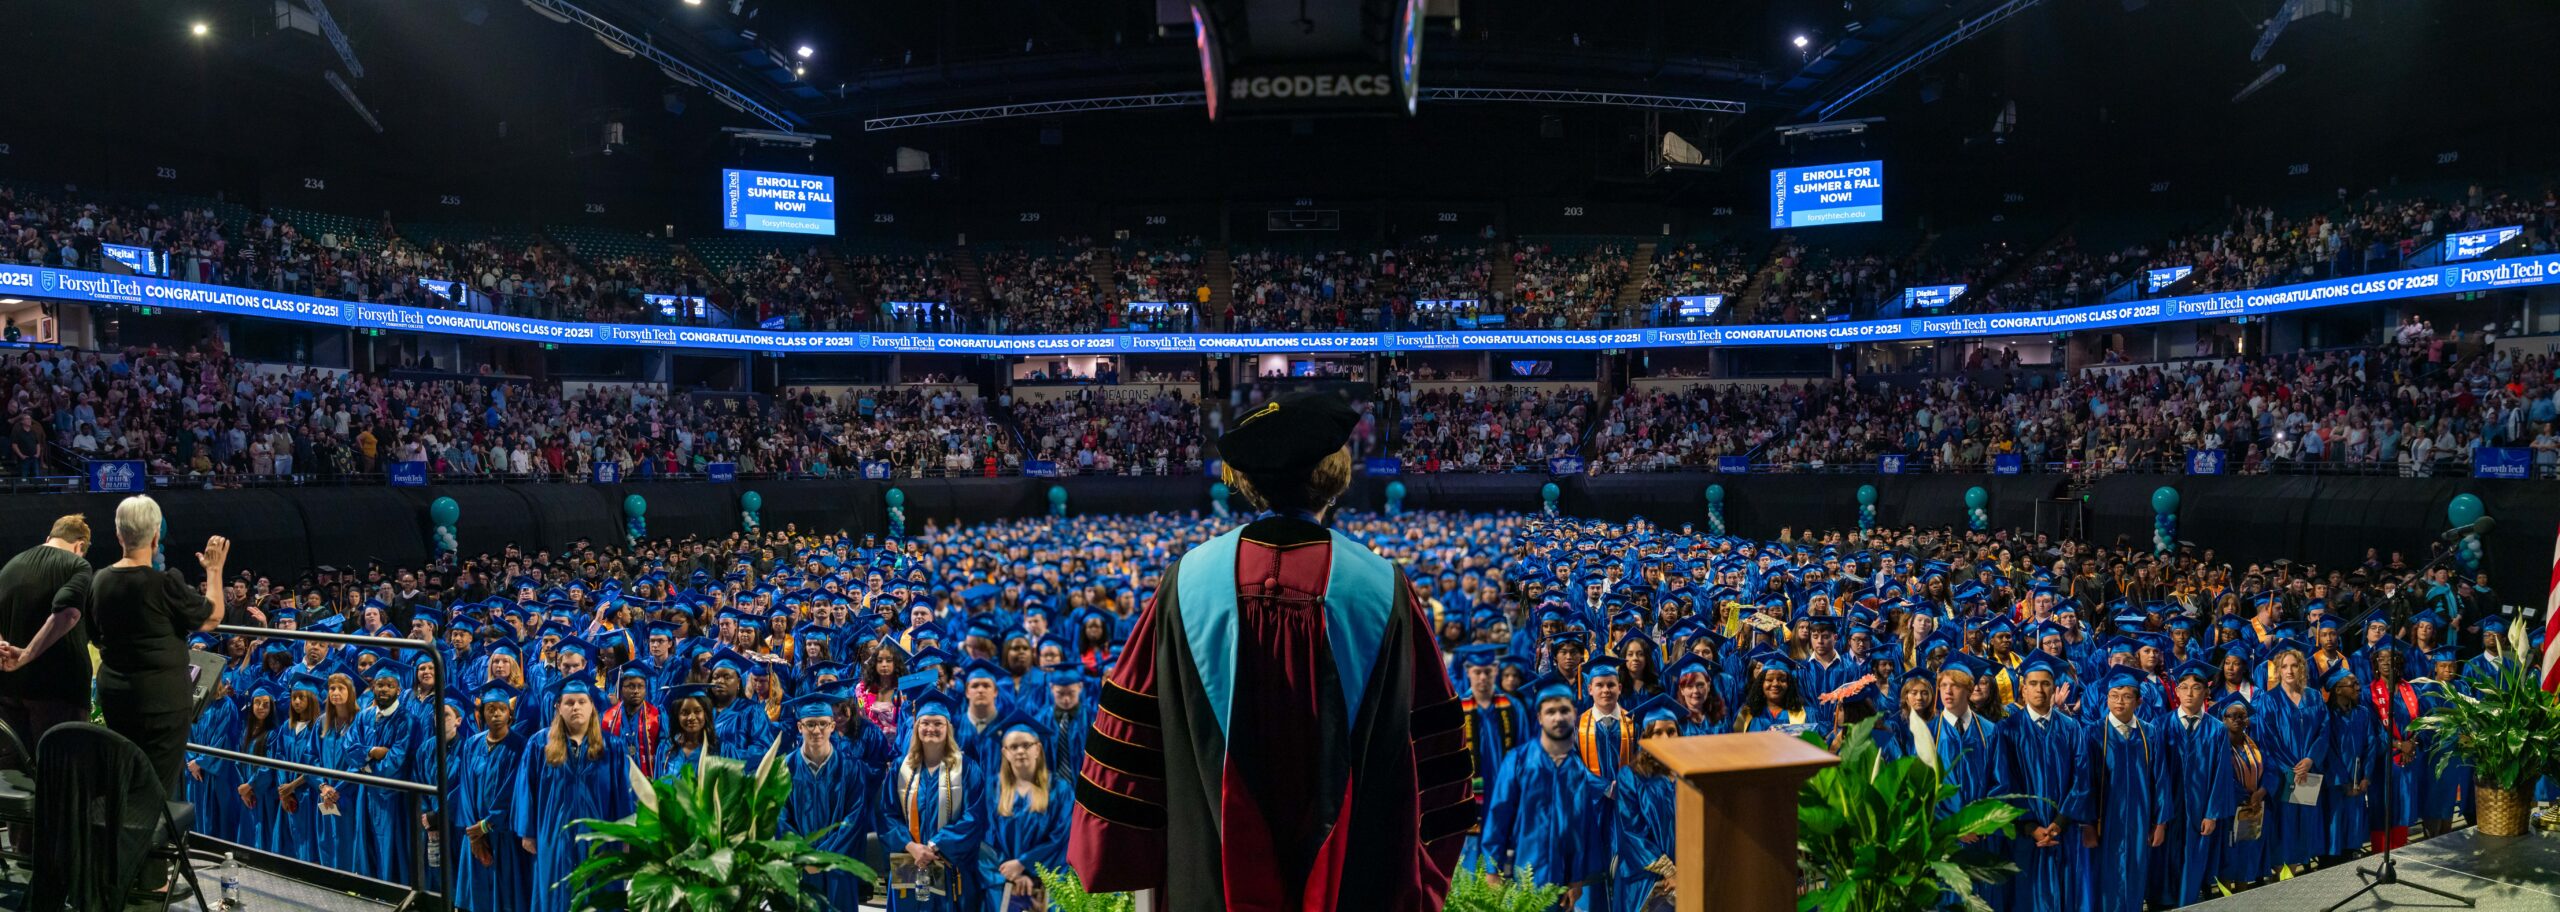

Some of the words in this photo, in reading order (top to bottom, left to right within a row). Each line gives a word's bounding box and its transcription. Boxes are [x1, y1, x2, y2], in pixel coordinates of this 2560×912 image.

[1231, 75, 1390, 98] #GODEACS
[2437, 152, 2459, 164] 209
[157, 167, 176, 179] 233
[1803, 169, 1846, 181] ENROLL
[1848, 167, 1870, 177] FOR
[2288, 164, 2309, 175] 208
[305, 178, 324, 189] 234
[729, 172, 737, 190] Tech
[757, 177, 800, 189] ENROLL
[801, 180, 823, 190] FOR
[1776, 171, 1784, 189] Tech
[1794, 182, 1841, 194] SUMMER
[1844, 180, 1852, 190] &
[1854, 178, 1880, 189] FALL
[2150, 182, 2170, 192] 207
[440, 195, 461, 205] 235
[748, 188, 796, 200] SUMMER
[798, 191, 806, 201] &
[808, 192, 832, 203] FALL
[1820, 192, 1852, 203] NOW!
[2004, 193, 2024, 202] 206
[585, 203, 605, 213] 236
[729, 191, 738, 218] Forsyth
[775, 201, 806, 212] NOW!
[1776, 189, 1785, 217] Forsyth
[1564, 207, 1583, 216] 203
[1713, 207, 1733, 215] 204
[1807, 211, 1866, 222] forsythtech.edu
[874, 214, 894, 223] 238
[1020, 213, 1040, 222] 239
[1146, 216, 1166, 225] 240
[1438, 213, 1458, 222] 202
[762, 219, 820, 230] forsythtech.edu
[2459, 235, 2486, 247] Digital
[108, 248, 135, 259] Digital
[2462, 265, 2508, 285] Forsyth
[2511, 261, 2543, 276] Tech
[60, 275, 108, 297] Forsyth
[111, 280, 141, 296] Tech
[2248, 285, 2349, 306] CONGRATULATIONS
[2351, 281, 2385, 294] CLASS
[2388, 278, 2404, 290] OF
[2406, 274, 2438, 288] 2025!
[94, 293, 121, 301] COMMUNITY
[146, 285, 259, 307] CONGRATULATIONS
[262, 298, 294, 311] CLASS
[297, 303, 310, 313] OF
[313, 304, 338, 316] 2025!
[1916, 290, 1938, 299] Digital
[2179, 296, 2217, 315] Forsyth
[2219, 295, 2243, 308] Tech
[359, 308, 396, 326] Forsyth
[398, 311, 423, 325] Tech
[1991, 313, 2087, 328] CONGRATULATIONS
[2089, 310, 2117, 321] CLASS
[2119, 308, 2132, 318] OF
[2134, 306, 2159, 317] 2025!
[427, 315, 520, 332] CONGRATULATIONS
[522, 324, 549, 336] CLASS
[551, 328, 563, 337] OF
[565, 328, 592, 337] 2025!
[1726, 329, 1827, 338] CONGRATULATIONS
[1830, 327, 1858, 336] CLASS
[1861, 326, 1873, 334] OF
[1876, 325, 1901, 334] 2025!
[1924, 319, 1961, 334] Forsyth
[1963, 318, 1987, 329] Tech
[614, 328, 650, 342] Forsyth
[651, 330, 677, 341] Tech
[680, 332, 773, 344] CONGRATULATIONS
[776, 337, 806, 345] CLASS
[1599, 335, 1612, 343] OF
[1615, 334, 1640, 342] 2025!
[1658, 331, 1696, 344] Forsyth
[1698, 330, 1721, 340] Tech
[873, 336, 908, 349] Forsyth
[910, 337, 935, 346] Tech
[939, 339, 1035, 348] CONGRATULATIONS
[1038, 340, 1068, 348] CLASS
[1087, 339, 1114, 347] 2025!
[1134, 337, 1170, 349] Forsyth
[1172, 337, 1195, 346] Tech
[1200, 338, 1298, 346] CONGRATULATIONS
[1302, 338, 1332, 346] CLASS
[1335, 338, 1348, 346] OF
[1397, 335, 1434, 348] Forsyth
[1436, 335, 1458, 344] Tech
[1034, 392, 1047, 400] WF
[723, 398, 739, 412] WF
[2480, 464, 2507, 475] Forsyth
[2508, 464, 2525, 474] Tech
[411, 474, 423, 482] Tech
[2376, 687, 2389, 727] TRIO
